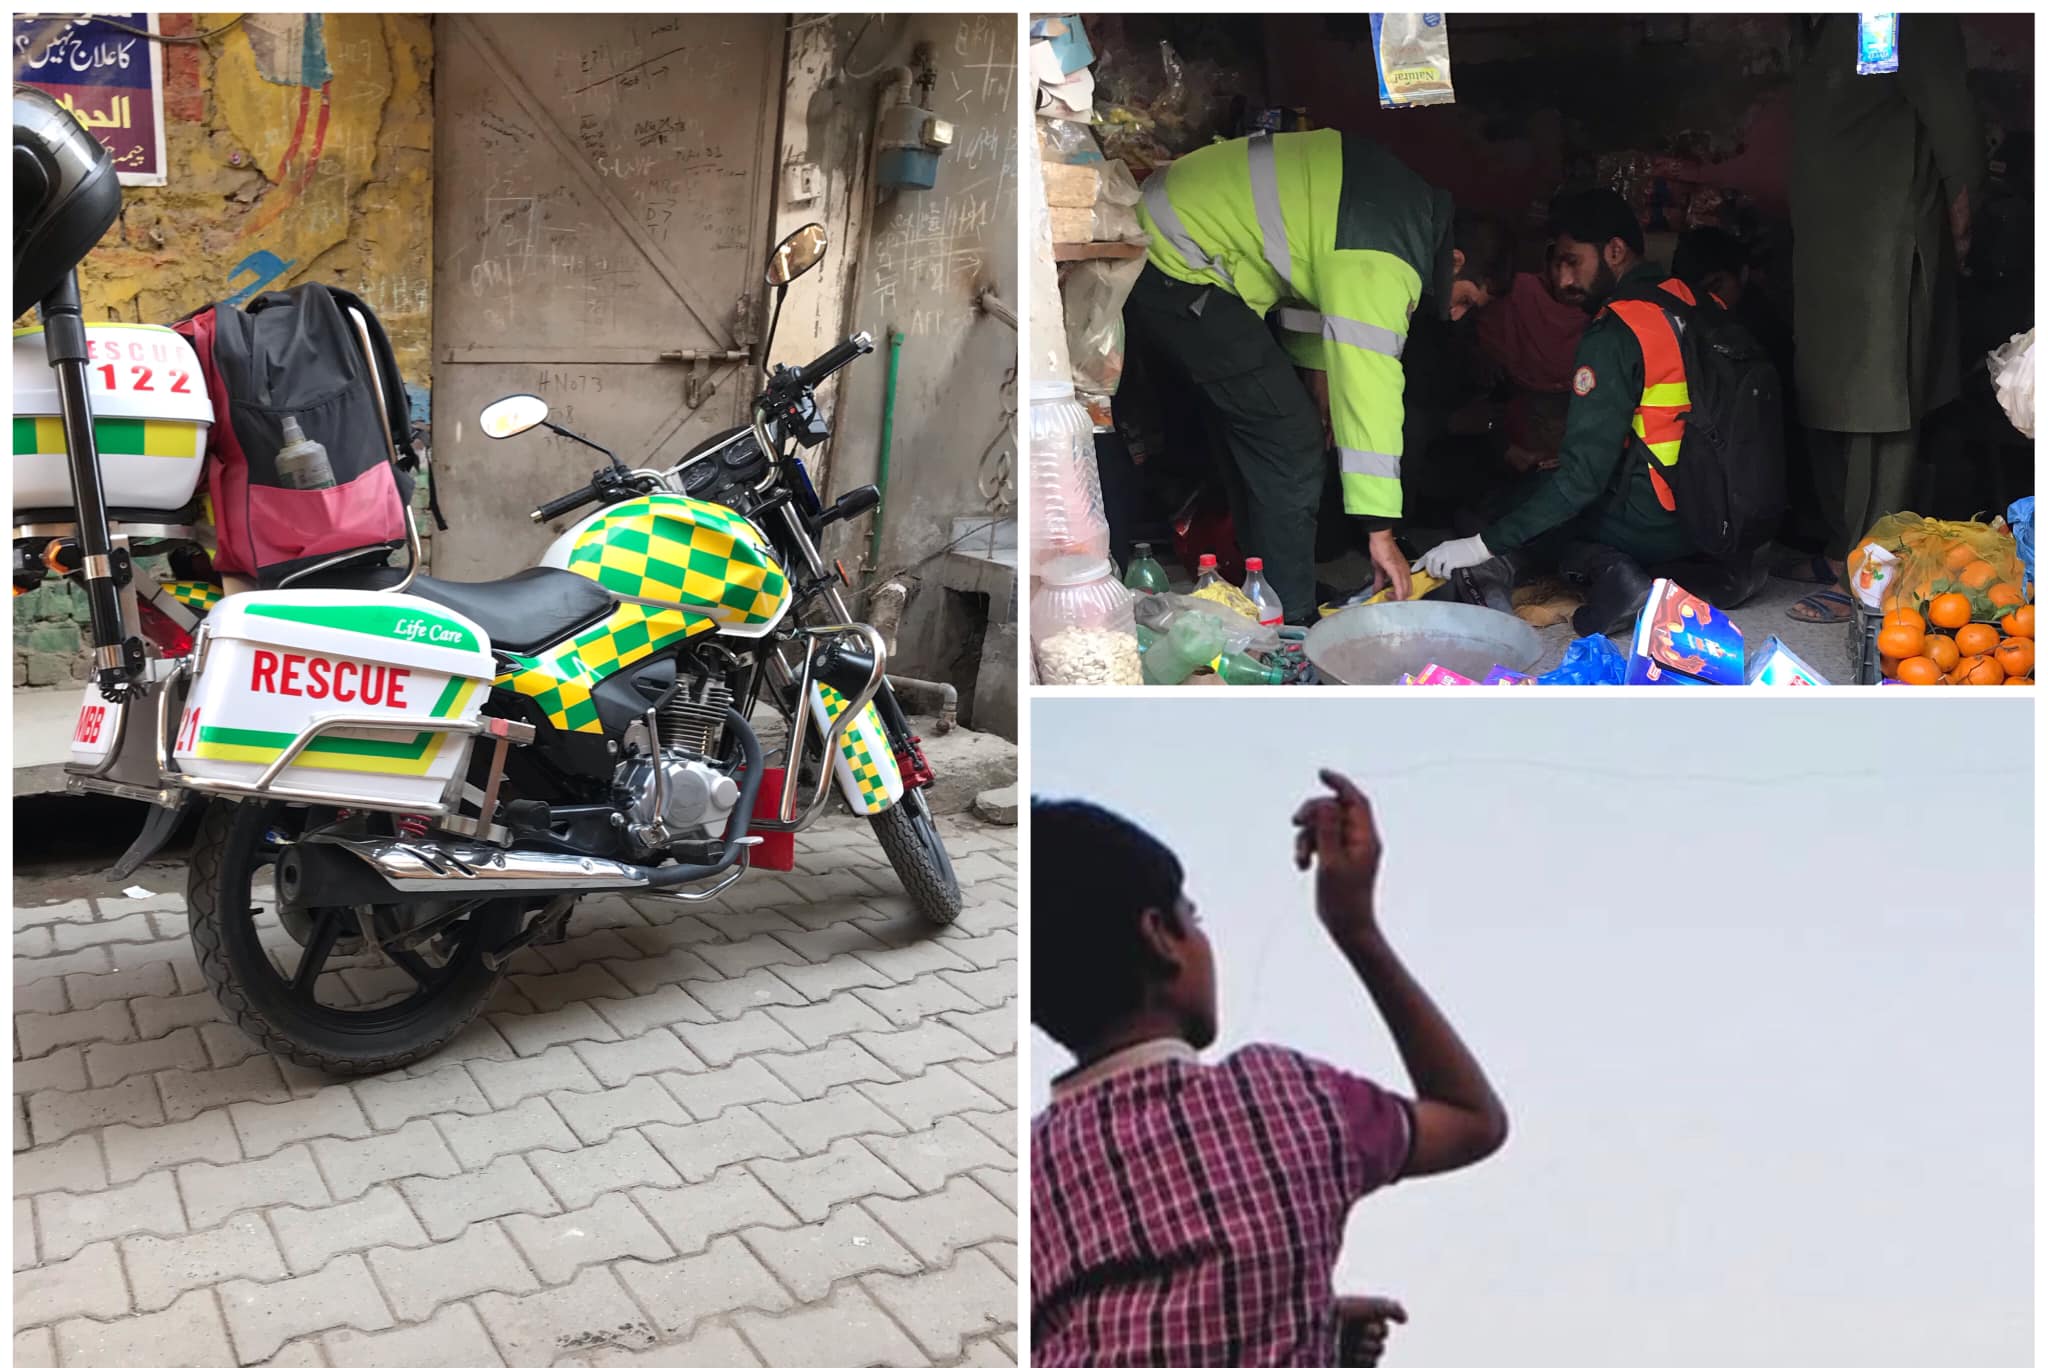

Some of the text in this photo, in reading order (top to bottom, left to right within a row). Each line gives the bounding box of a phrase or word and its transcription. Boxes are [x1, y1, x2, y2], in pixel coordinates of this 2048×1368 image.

[96, 363, 192, 394] 122
[393, 618, 463, 644] Life Care
[250, 649, 411, 709] RESCUE
